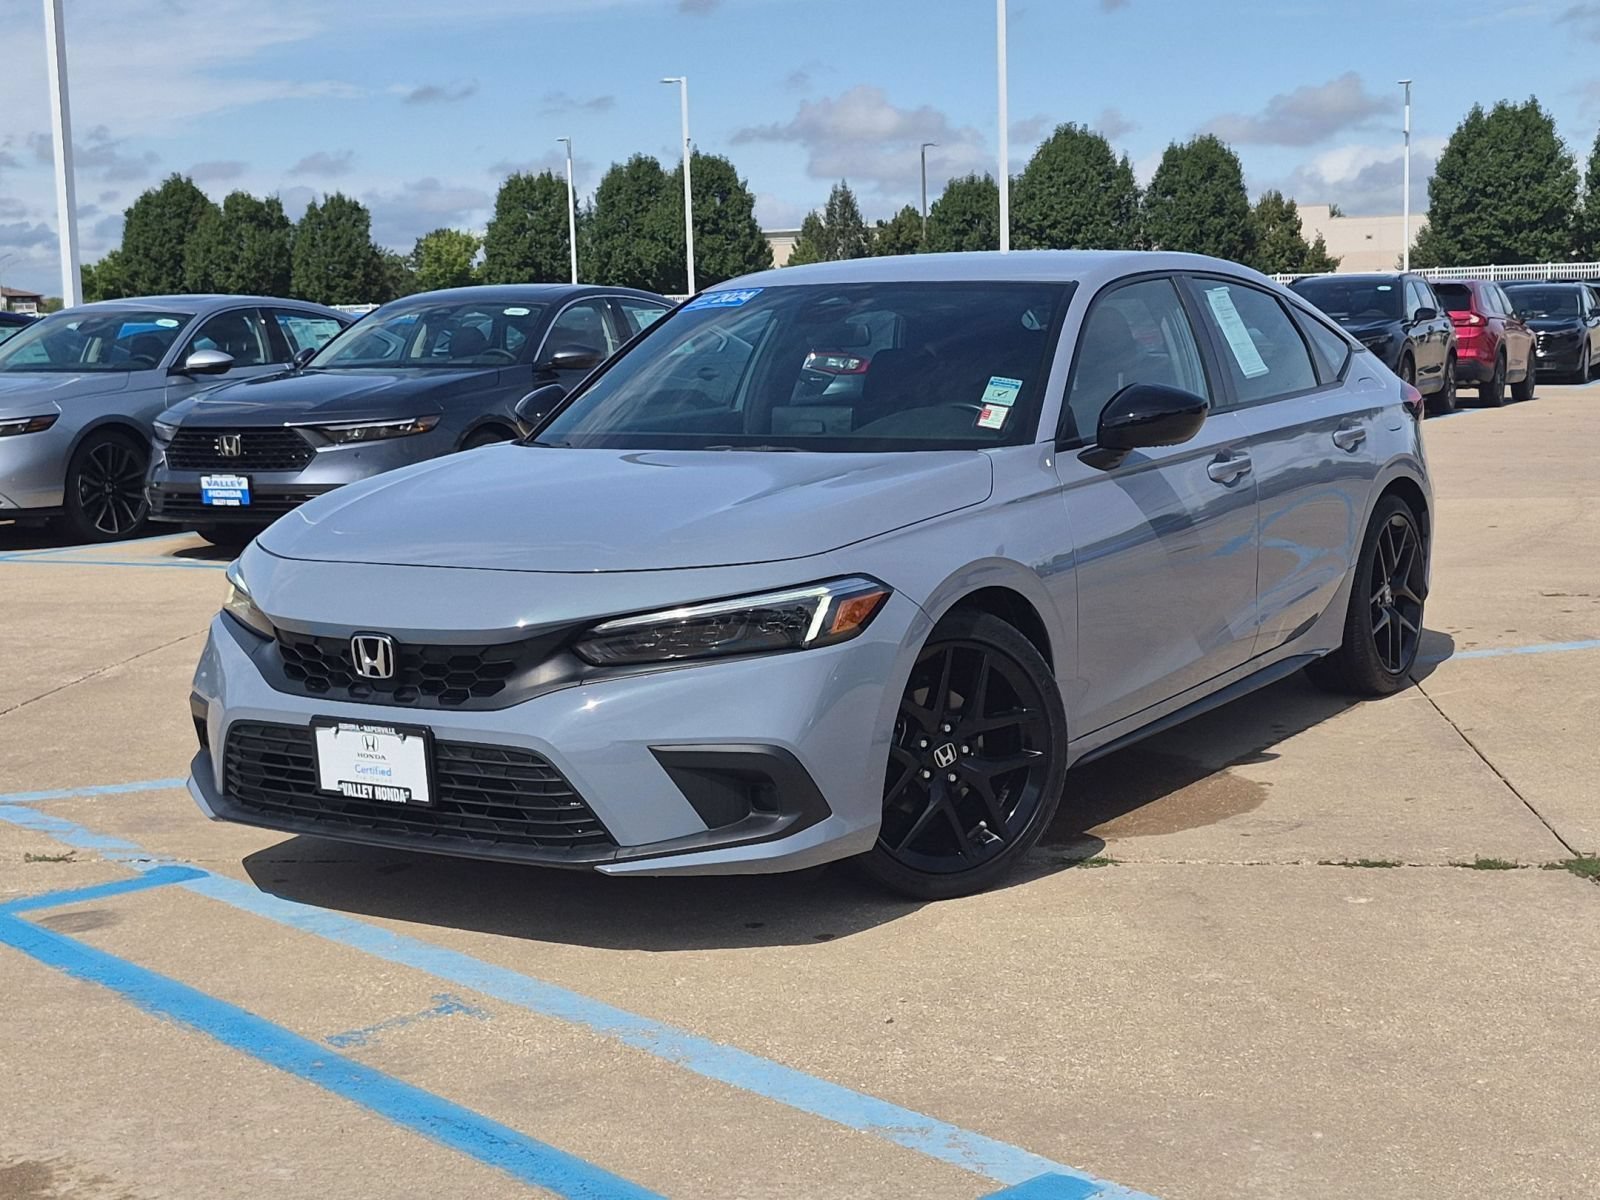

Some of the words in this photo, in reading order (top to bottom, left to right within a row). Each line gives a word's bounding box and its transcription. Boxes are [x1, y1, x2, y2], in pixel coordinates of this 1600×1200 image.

[207, 489, 243, 498] HONDA
[357, 752, 387, 760] HONDA
[355, 764, 392, 776] Certified
[342, 782, 374, 799] VALLEY
[374, 786, 407, 803] HONDA
